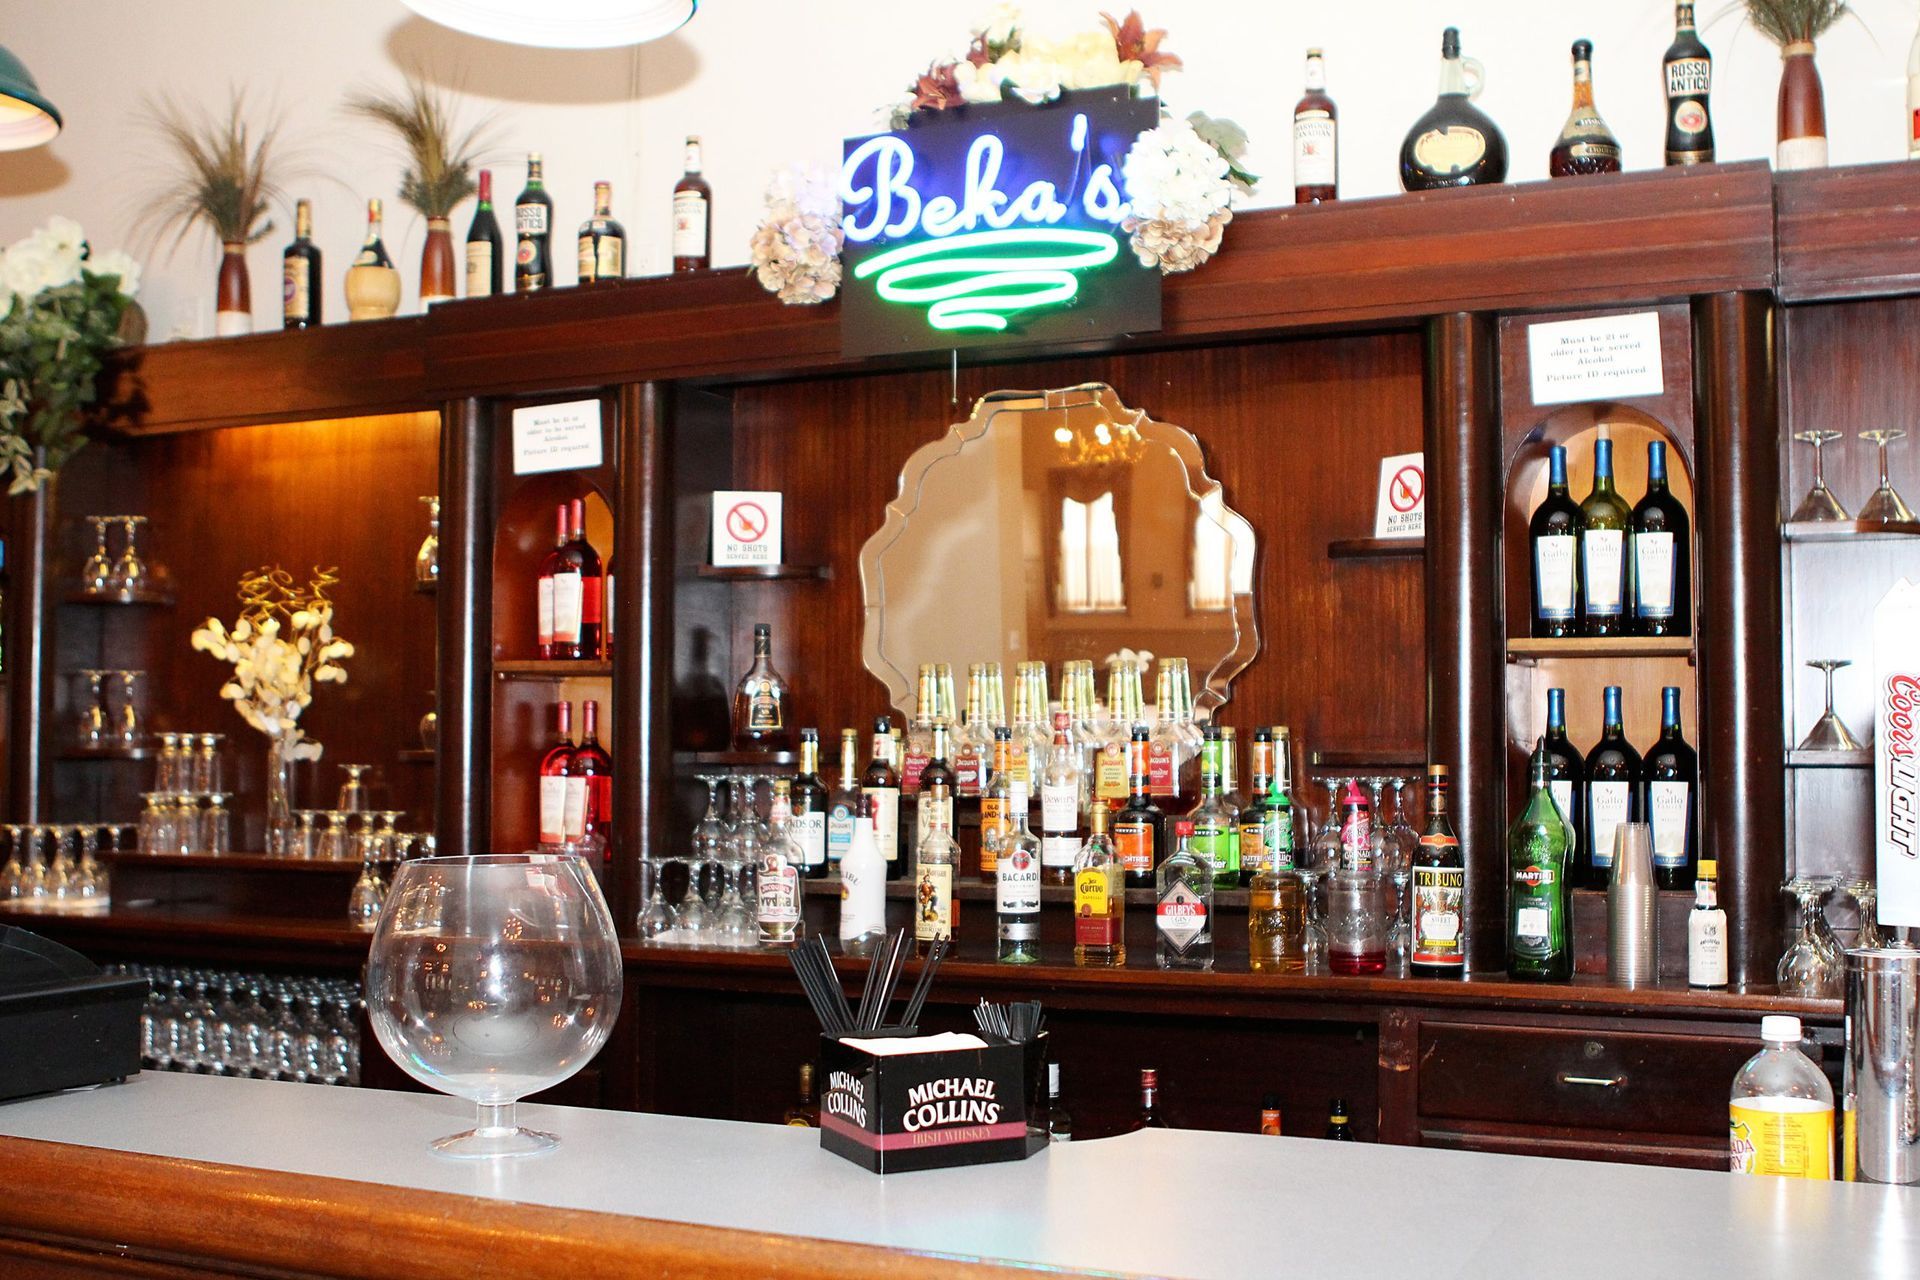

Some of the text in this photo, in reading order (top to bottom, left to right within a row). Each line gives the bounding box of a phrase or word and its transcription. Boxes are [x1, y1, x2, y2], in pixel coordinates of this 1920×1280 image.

[1671, 62, 1708, 78] ROSSO
[1671, 76, 1709, 93] ANTICO
[841, 112, 1133, 242] Beka's
[1560, 336, 1585, 345] Must
[1590, 335, 1602, 343] be
[1608, 341, 1641, 351] served
[1577, 356, 1614, 365] Alcohol
[1546, 366, 1647, 382] Picture ID required
[1387, 511, 1423, 525] NO SHOTS
[726, 544, 768, 552] NO SHOTS
[1888, 674, 1920, 857] Coors LIGHT
[791, 818, 822, 829] NDSOR
[1419, 872, 1463, 887] TRIBUNO
[1516, 871, 1552, 881] MARTINI
[1165, 903, 1196, 916] GILBEY'S
[829, 1070, 865, 1104] MICHAEL
[907, 1077, 996, 1107] MICHAEL
[827, 1092, 867, 1129] COLLINS
[902, 1100, 1001, 1132] COLLINS
[912, 1128, 993, 1145] IRISH WHISKEY
[1731, 1139, 1755, 1154] ADA
